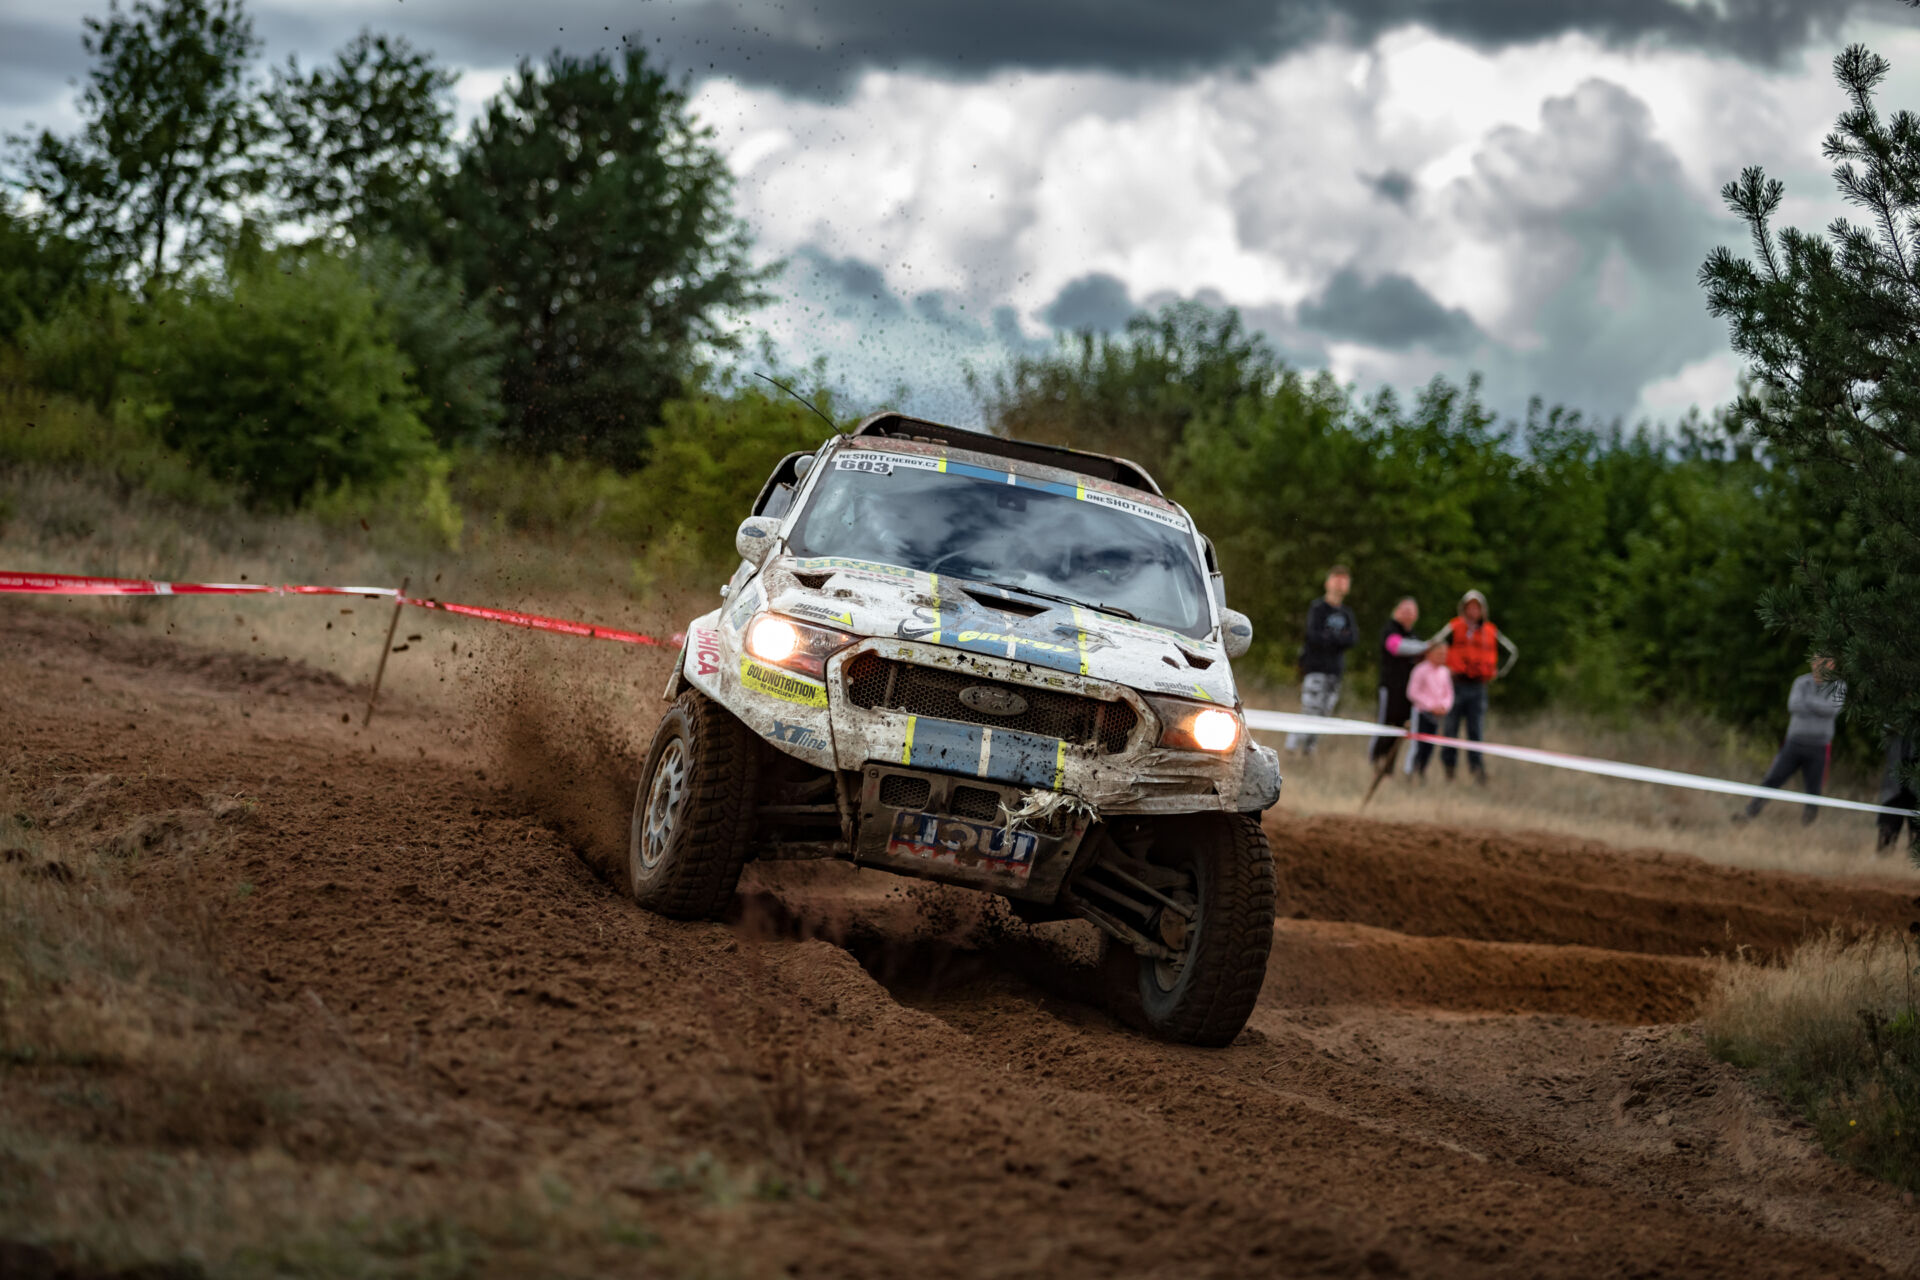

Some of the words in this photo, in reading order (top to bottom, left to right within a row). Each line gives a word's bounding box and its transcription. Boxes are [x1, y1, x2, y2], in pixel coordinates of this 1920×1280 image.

[839, 459, 891, 473] 603
[794, 602, 841, 618] agados
[746, 664, 817, 700] GOLDNUTRITION
[765, 719, 827, 751] XTline
